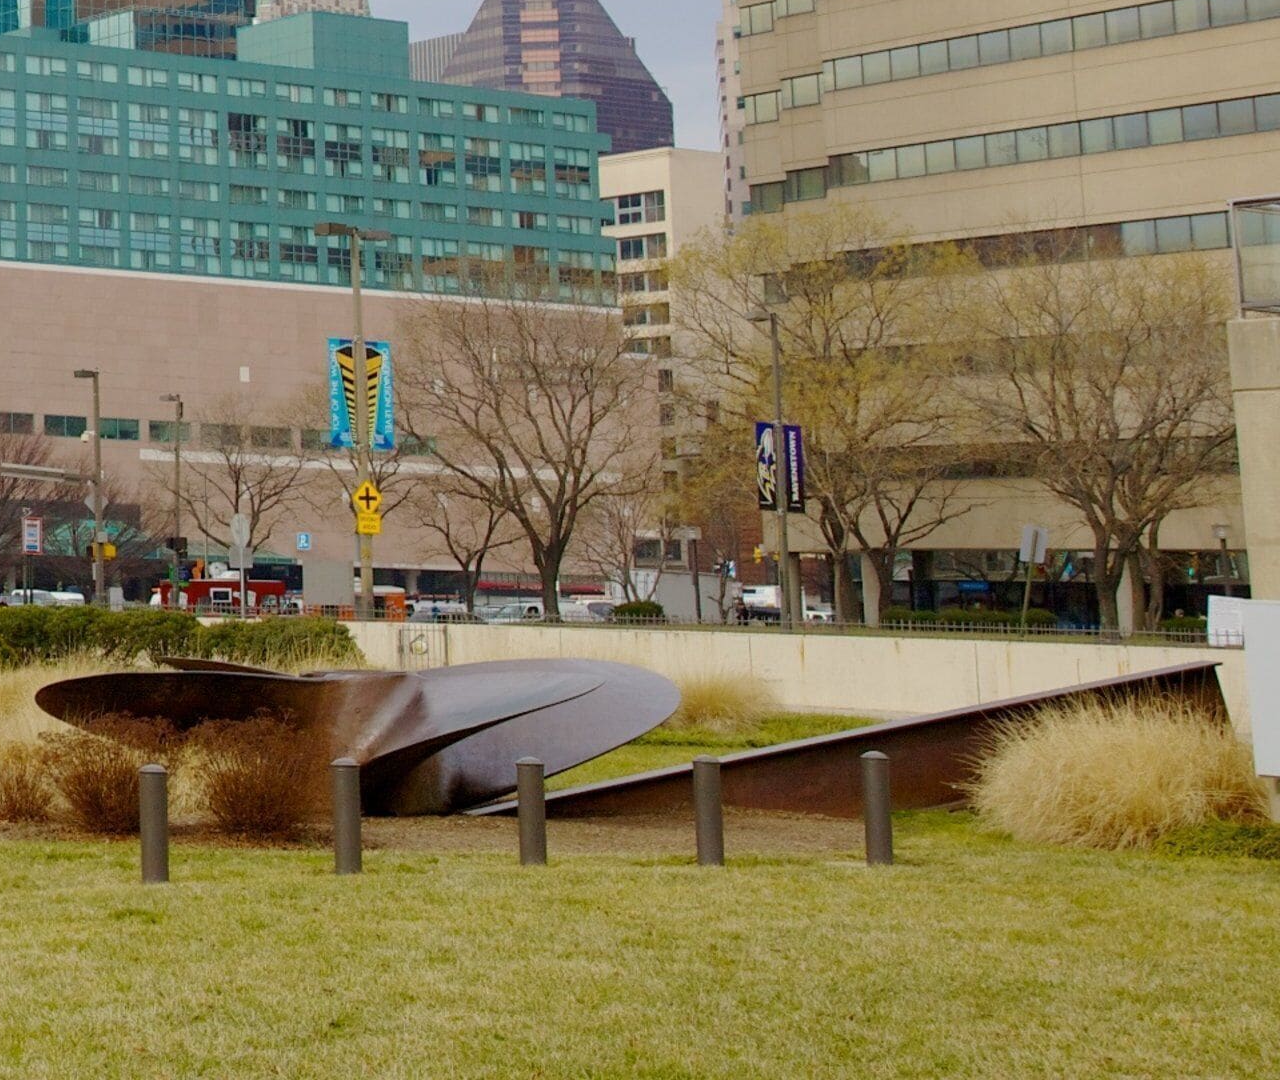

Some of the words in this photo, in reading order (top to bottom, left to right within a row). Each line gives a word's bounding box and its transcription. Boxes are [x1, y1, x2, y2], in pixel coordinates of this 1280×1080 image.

[331, 380, 339, 395] THE
[384, 411, 393, 433] LEVEL
[788, 431, 800, 502] RAVENSTOWN
